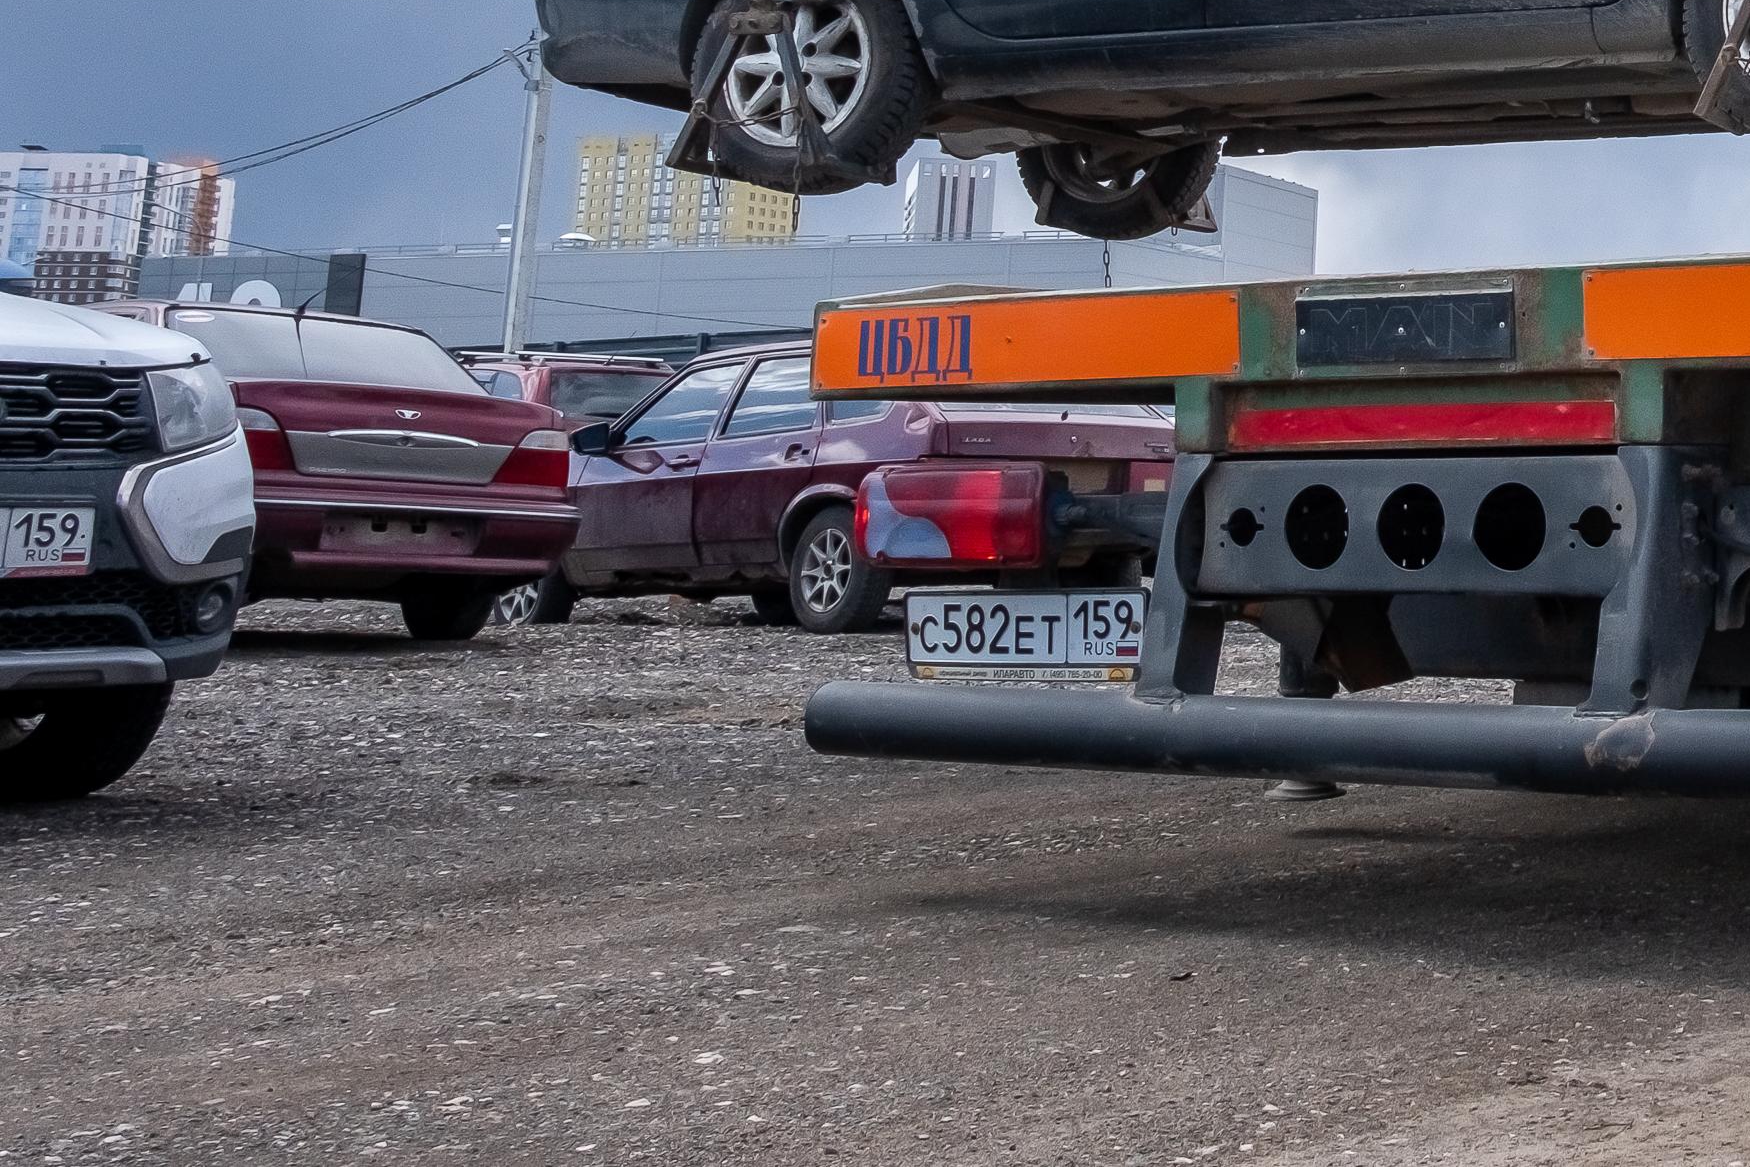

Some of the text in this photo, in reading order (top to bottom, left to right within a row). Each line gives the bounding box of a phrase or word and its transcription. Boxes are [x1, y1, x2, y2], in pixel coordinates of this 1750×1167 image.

[1311, 302, 1495, 352] MAN
[859, 315, 973, 383] ЦБДД
[14, 513, 80, 548] 159
[25, 549, 60, 562] RUS
[920, 600, 1134, 655] С582ЕТ 159
[1083, 641, 1115, 656] RUS
